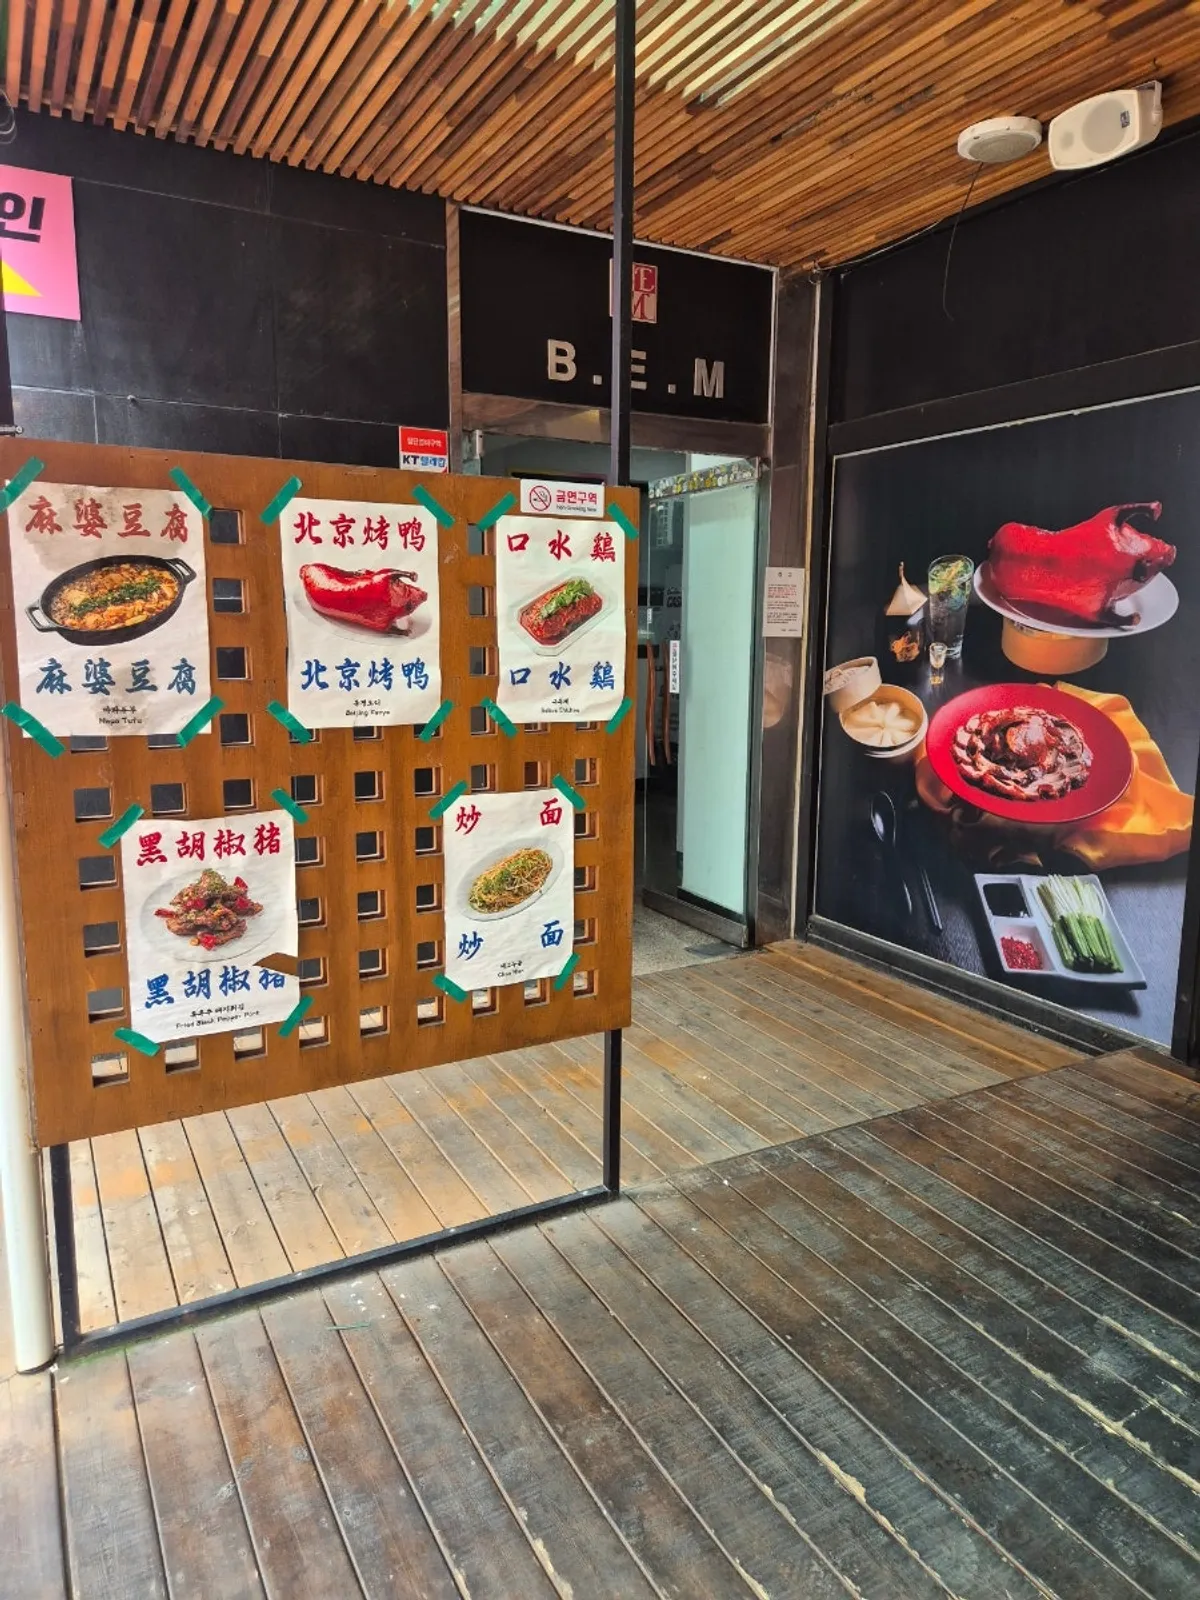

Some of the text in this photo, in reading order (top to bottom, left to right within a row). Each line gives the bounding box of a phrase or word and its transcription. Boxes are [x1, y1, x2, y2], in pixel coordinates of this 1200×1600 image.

[556, 490, 597, 505] 금연구역
[25, 495, 189, 542] 麻婆豆腐
[293, 511, 426, 552] 北京烤鸭
[36, 657, 197, 695] 麻婆豆腐
[300, 657, 429, 691] 北京烤鸭
[455, 797, 563, 835] 炒面
[136, 821, 281, 867] 黑胡椒猪
[457, 919, 564, 960] 炒面
